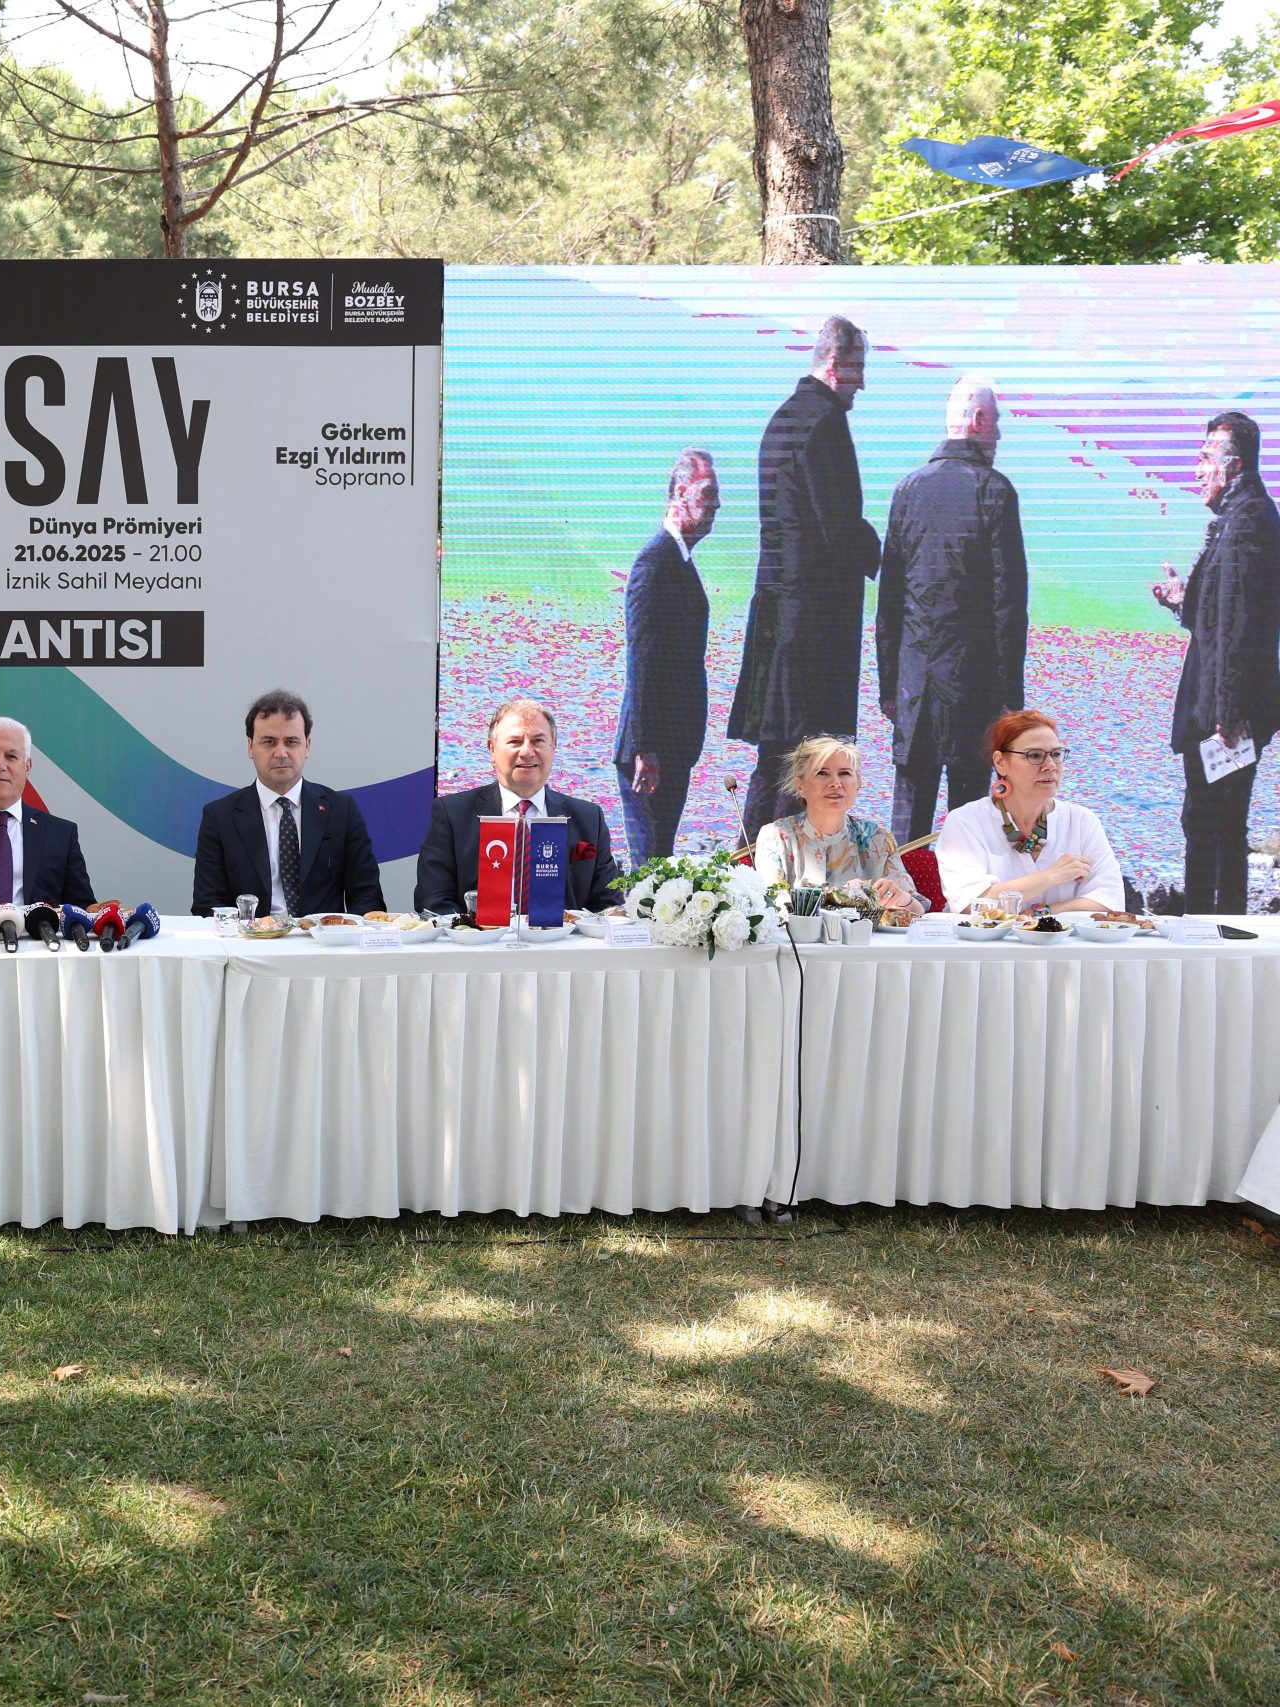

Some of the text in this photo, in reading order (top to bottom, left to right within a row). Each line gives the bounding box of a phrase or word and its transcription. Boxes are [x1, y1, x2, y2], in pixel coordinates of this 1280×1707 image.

[247, 281, 320, 296] BURSA
[351, 281, 395, 297] Mustafa
[246, 297, 319, 311] BÜYÜKŞEHİR
[344, 295, 404, 307] BOZBEY
[246, 310, 319, 323] BELEDİYESİ
[376, 316, 405, 324] BAŞKANI
[4, 355, 211, 506] SAY
[321, 422, 406, 441] Görkem
[276, 447, 406, 468] Ezgi Yıldırım
[314, 467, 406, 490] Soprano
[29, 517, 202, 538] Dünya Prömiyeri
[14, 544, 126, 562] 21.06.2025
[149, 544, 202, 562] 21.00
[6, 567, 202, 593] İznik Sahil Meydanı
